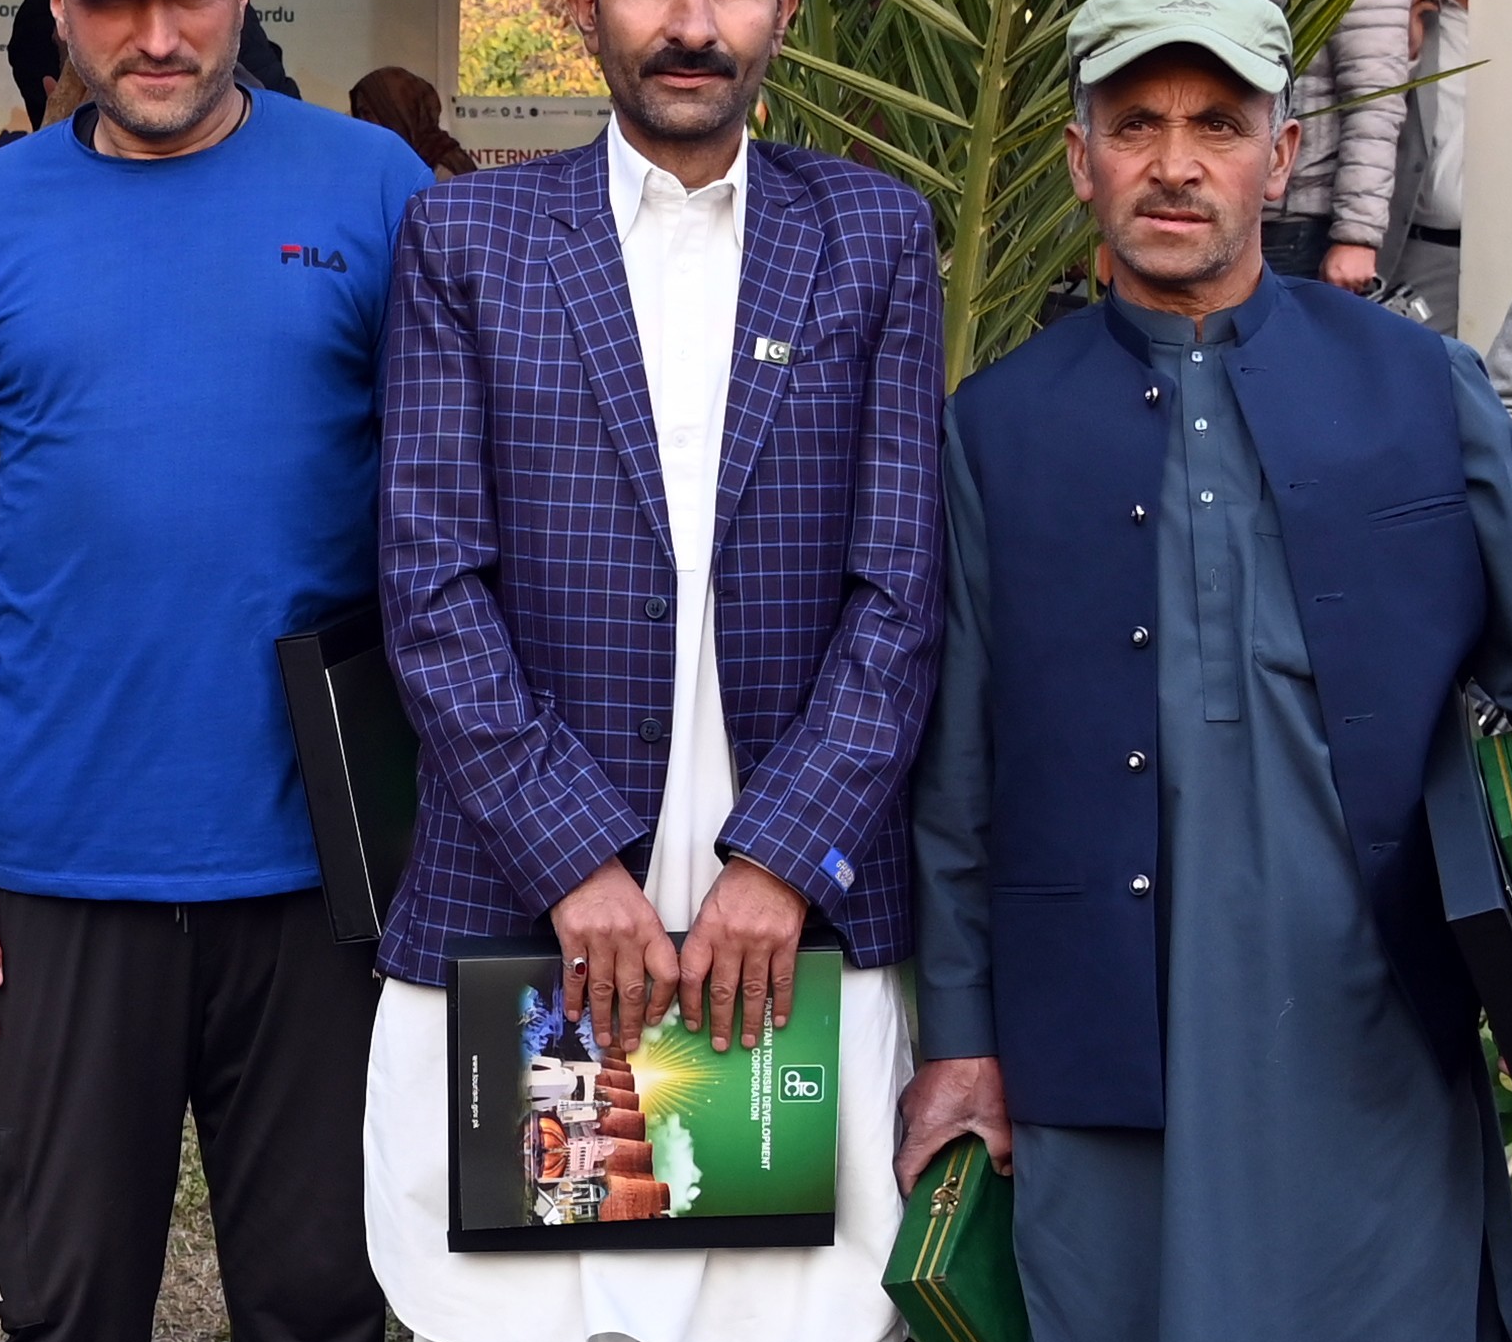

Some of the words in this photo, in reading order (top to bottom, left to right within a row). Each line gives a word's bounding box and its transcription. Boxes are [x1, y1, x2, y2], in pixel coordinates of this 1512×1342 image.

[280, 244, 347, 273] FILA
[763, 997, 773, 1047] PAKISTAN
[750, 1047, 761, 1121] CORPORATION
[762, 1048, 773, 1094] TOURISM
[761, 1095, 772, 1171] DEVELOPMENT
